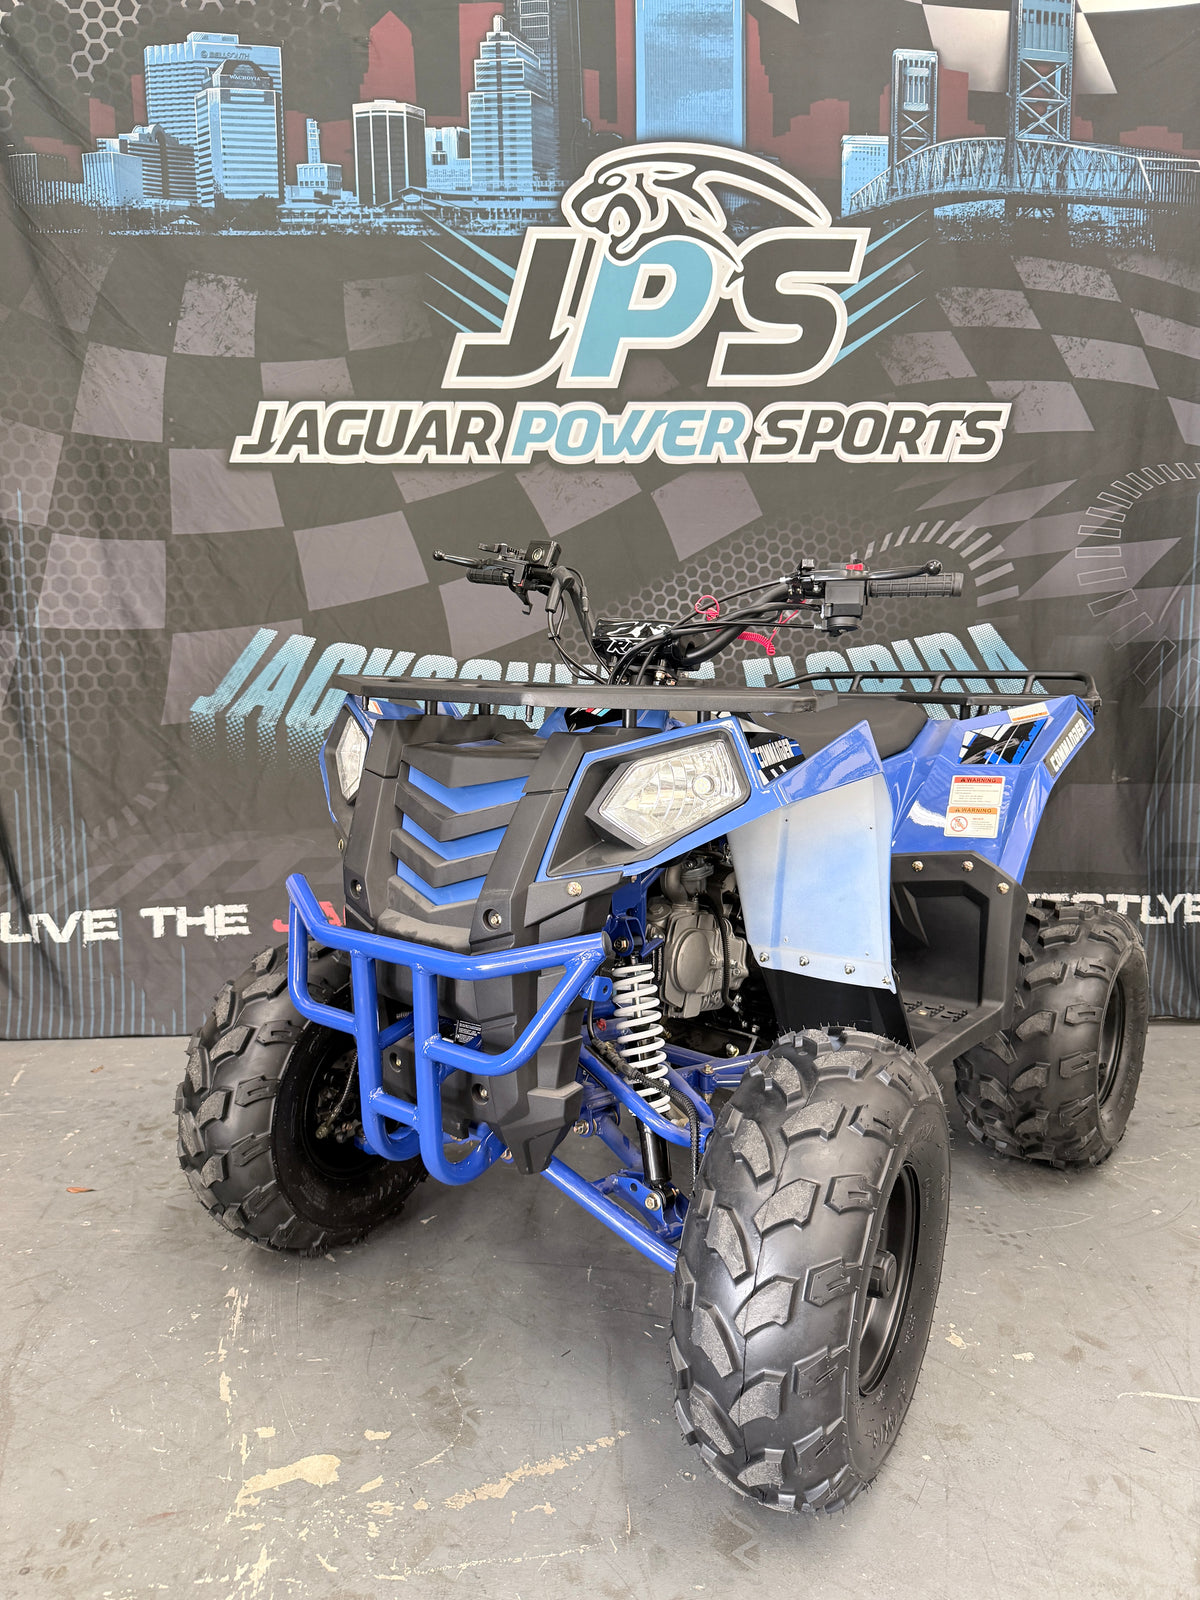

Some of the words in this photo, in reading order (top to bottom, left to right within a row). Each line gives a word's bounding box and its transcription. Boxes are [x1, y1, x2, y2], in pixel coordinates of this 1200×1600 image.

[442, 226, 871, 389] JPS
[229, 401, 504, 465] JAGUAR
[501, 401, 750, 465] POWER
[750, 401, 1012, 464] SPORTS
[0, 908, 121, 946] LIVE
[139, 903, 251, 941] THE
